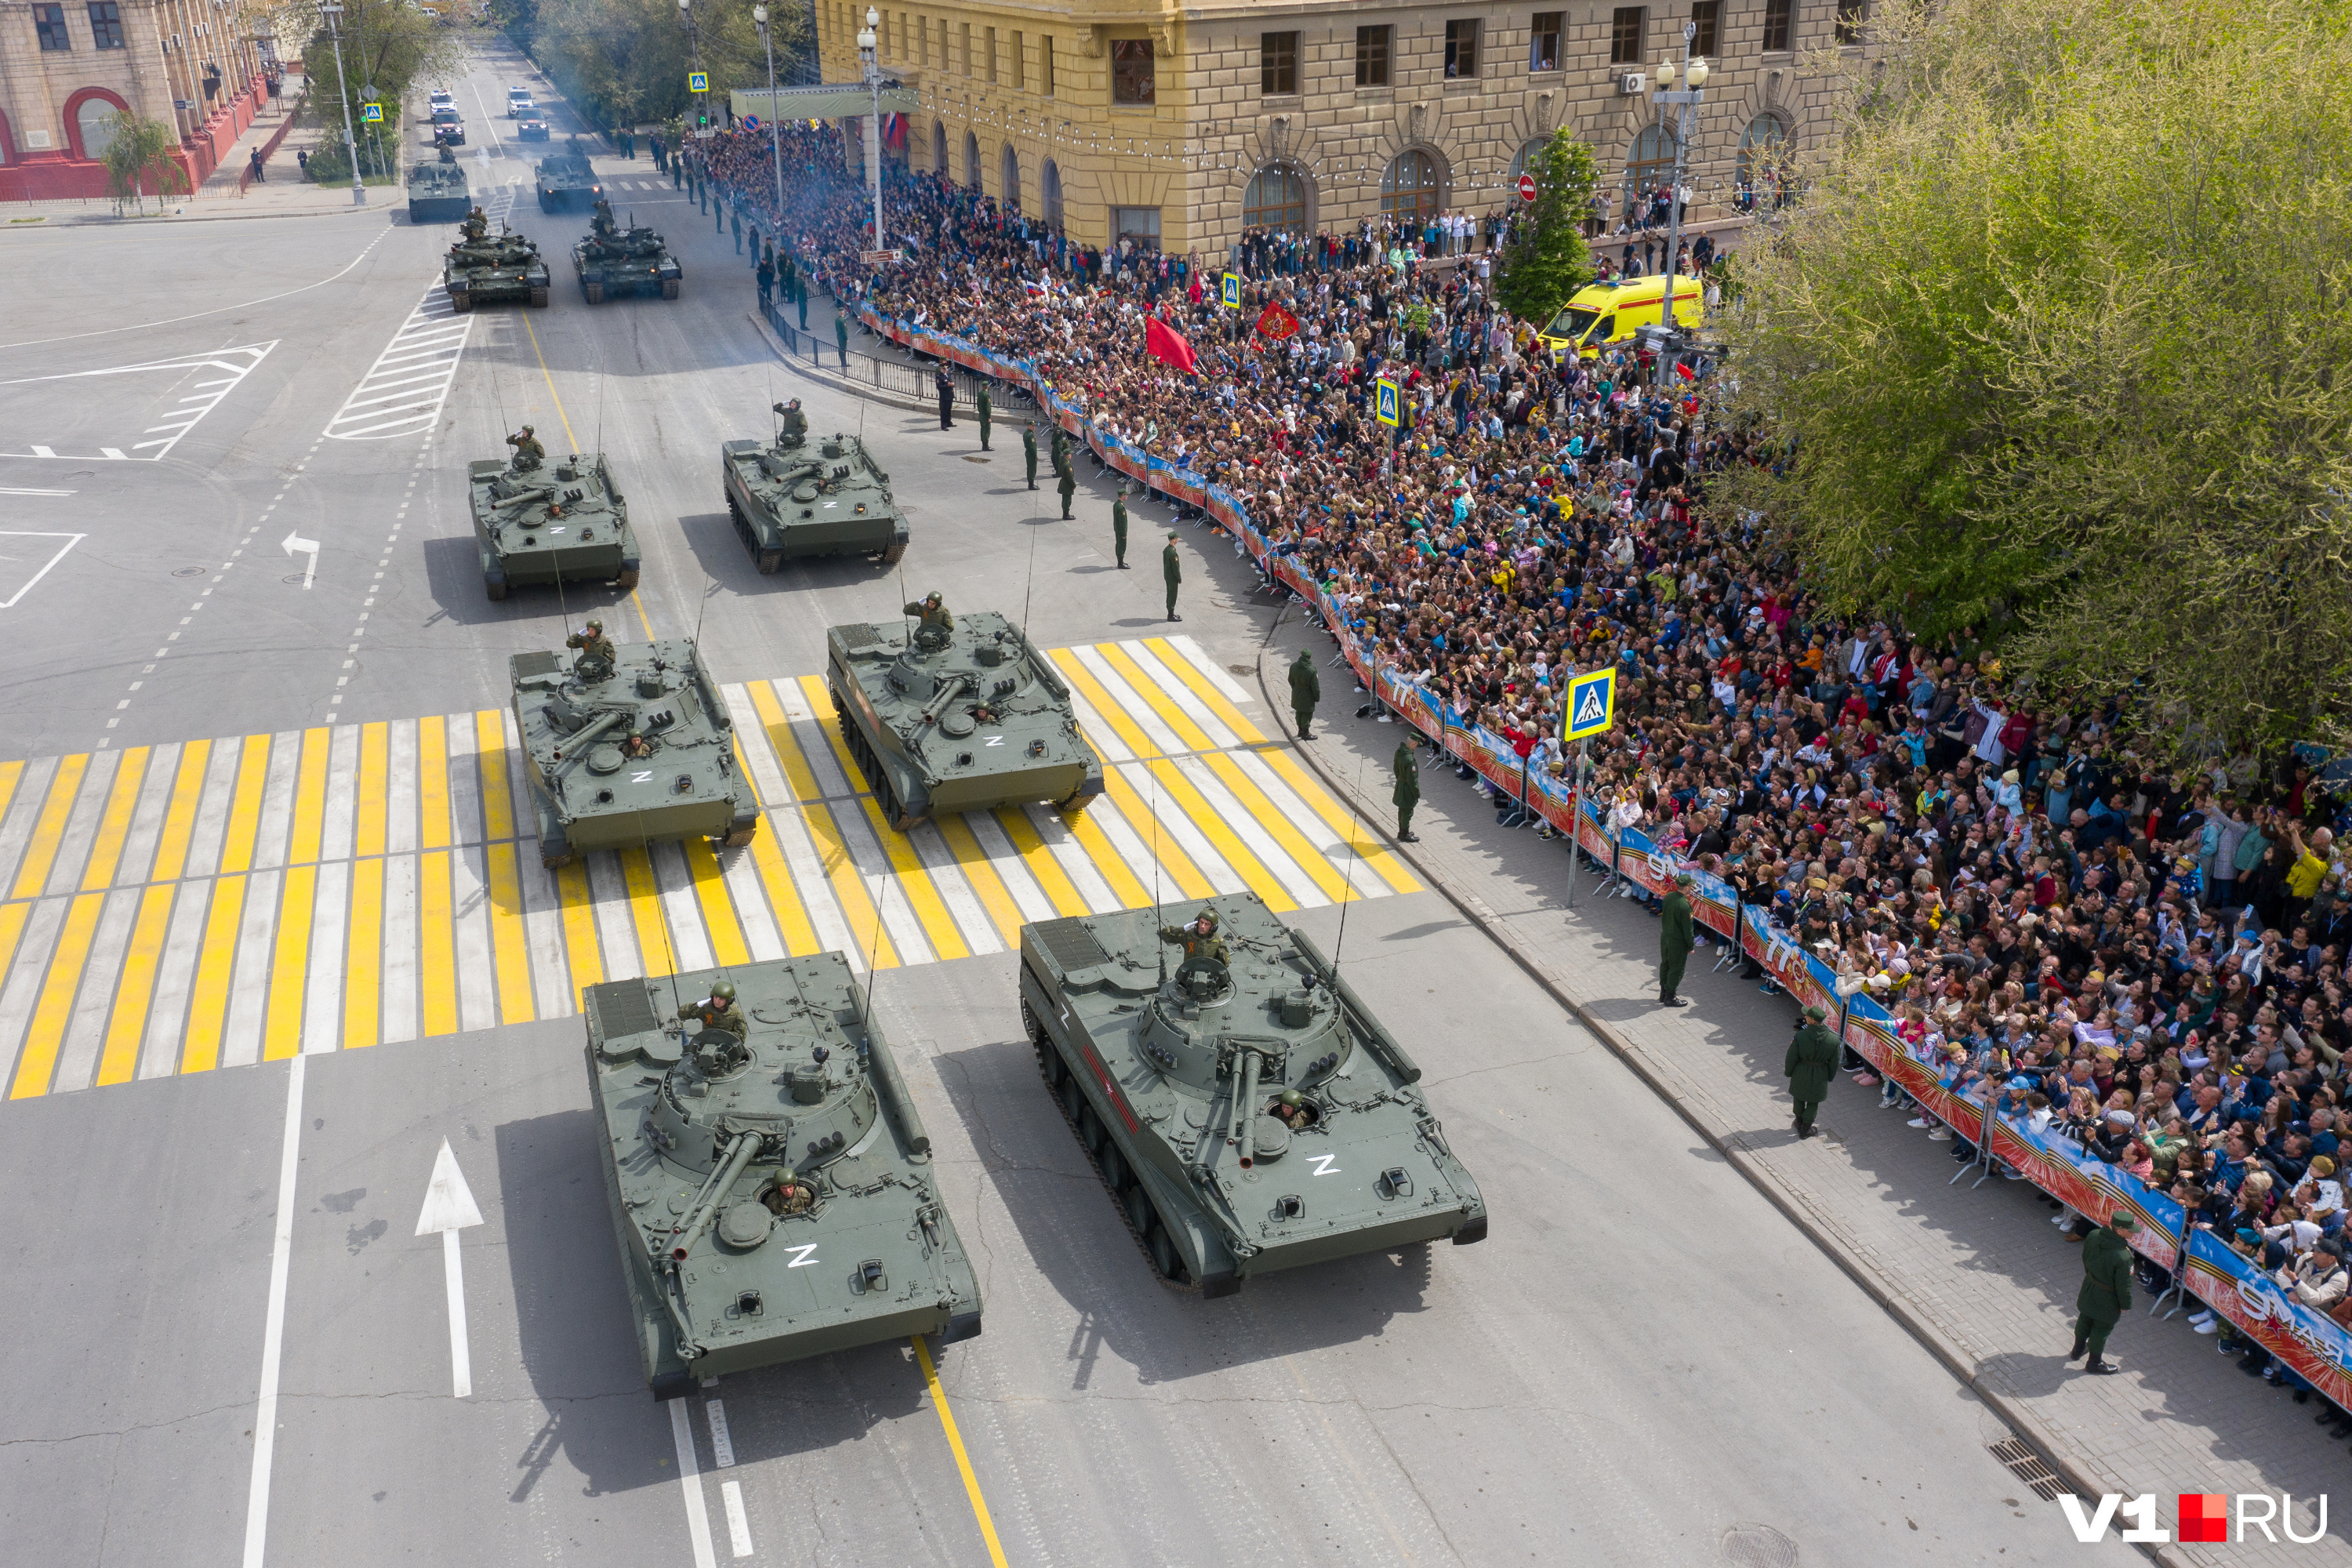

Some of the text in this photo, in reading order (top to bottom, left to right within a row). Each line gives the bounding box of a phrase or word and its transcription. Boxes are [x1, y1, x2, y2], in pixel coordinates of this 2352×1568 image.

[550, 526, 566, 535] Z
[1392, 677, 1410, 708] 77
[982, 735, 1006, 747] Z
[630, 770, 654, 783] Z
[1647, 853, 1666, 881] 9
[1766, 929, 1793, 973] 77
[1306, 1153, 1342, 1177] Z
[784, 1243, 820, 1269] Z
[2237, 1279, 2345, 1367] 9 МАЯ
[2288, 1330, 2341, 1372] 1945-2022
